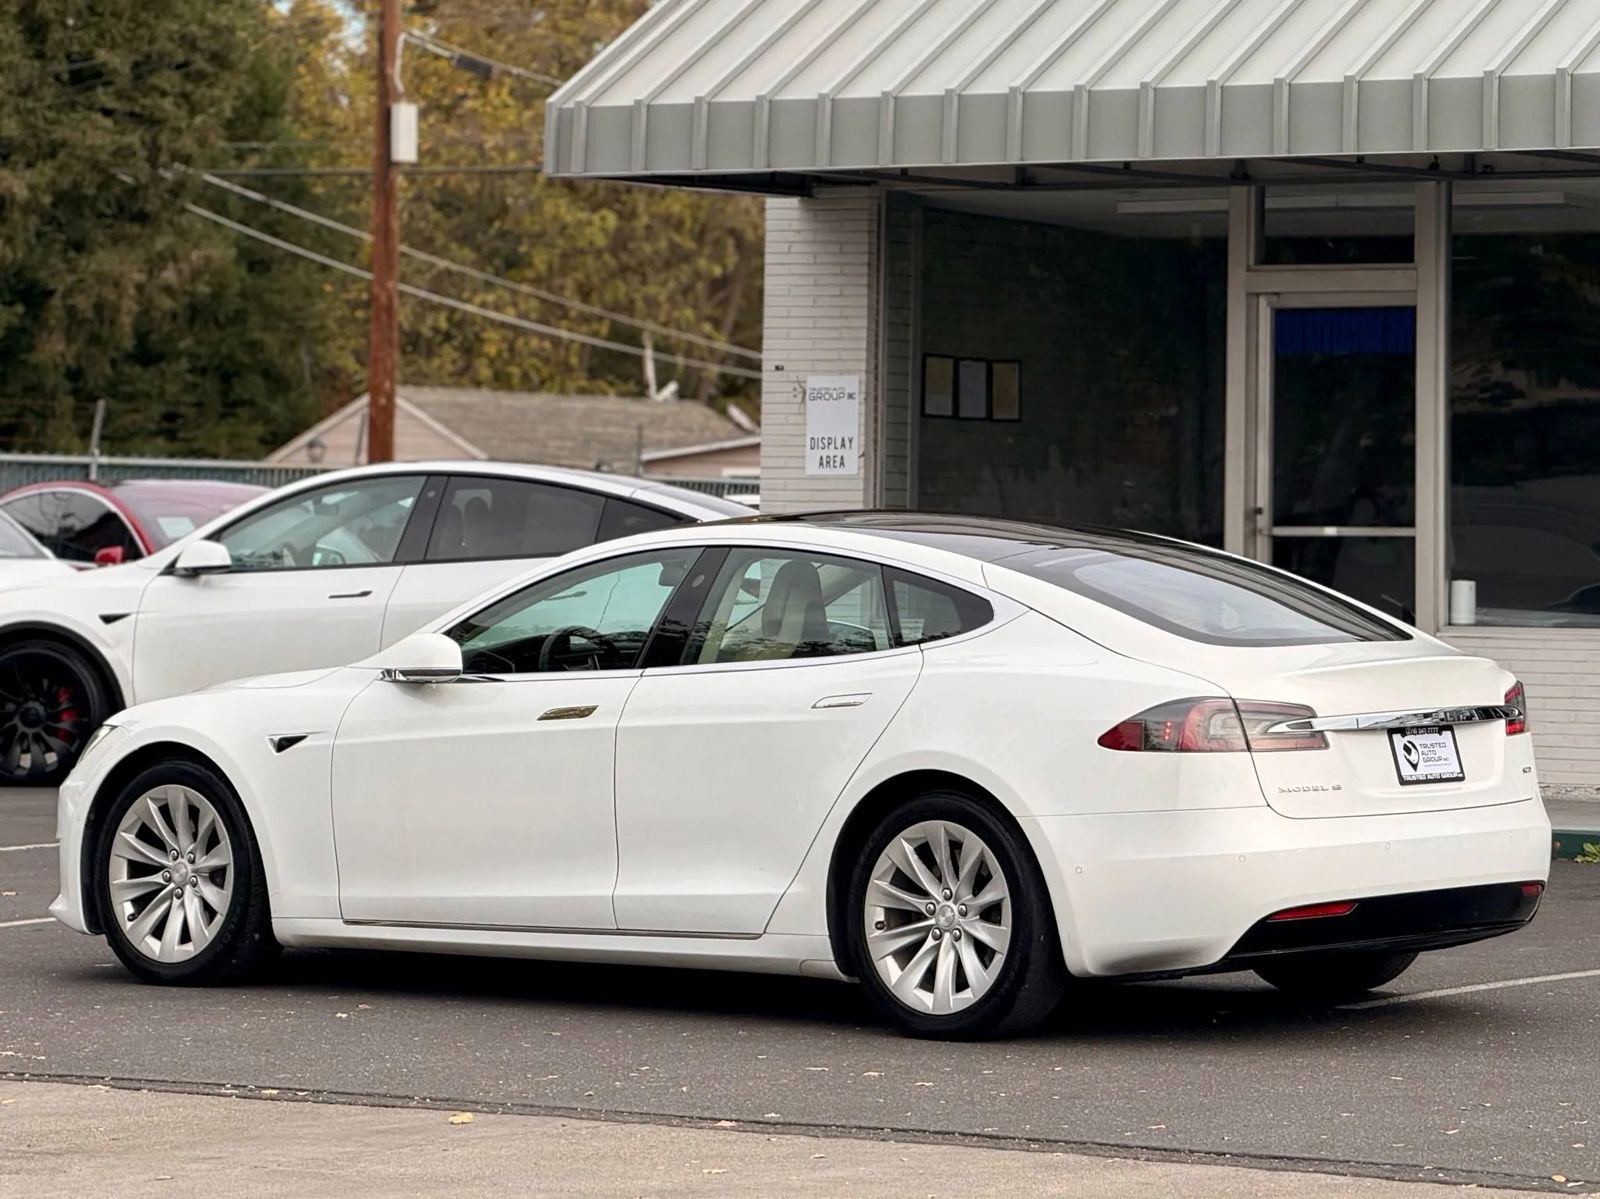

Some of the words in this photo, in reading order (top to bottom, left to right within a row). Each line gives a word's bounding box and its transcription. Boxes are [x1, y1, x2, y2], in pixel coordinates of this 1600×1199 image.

[808, 391, 846, 401] GROUP
[810, 436, 854, 451] DISPLAY
[818, 455, 846, 469] AREA
[1419, 742, 1447, 750] TRUSTED
[1278, 784, 1329, 794] MODEL
